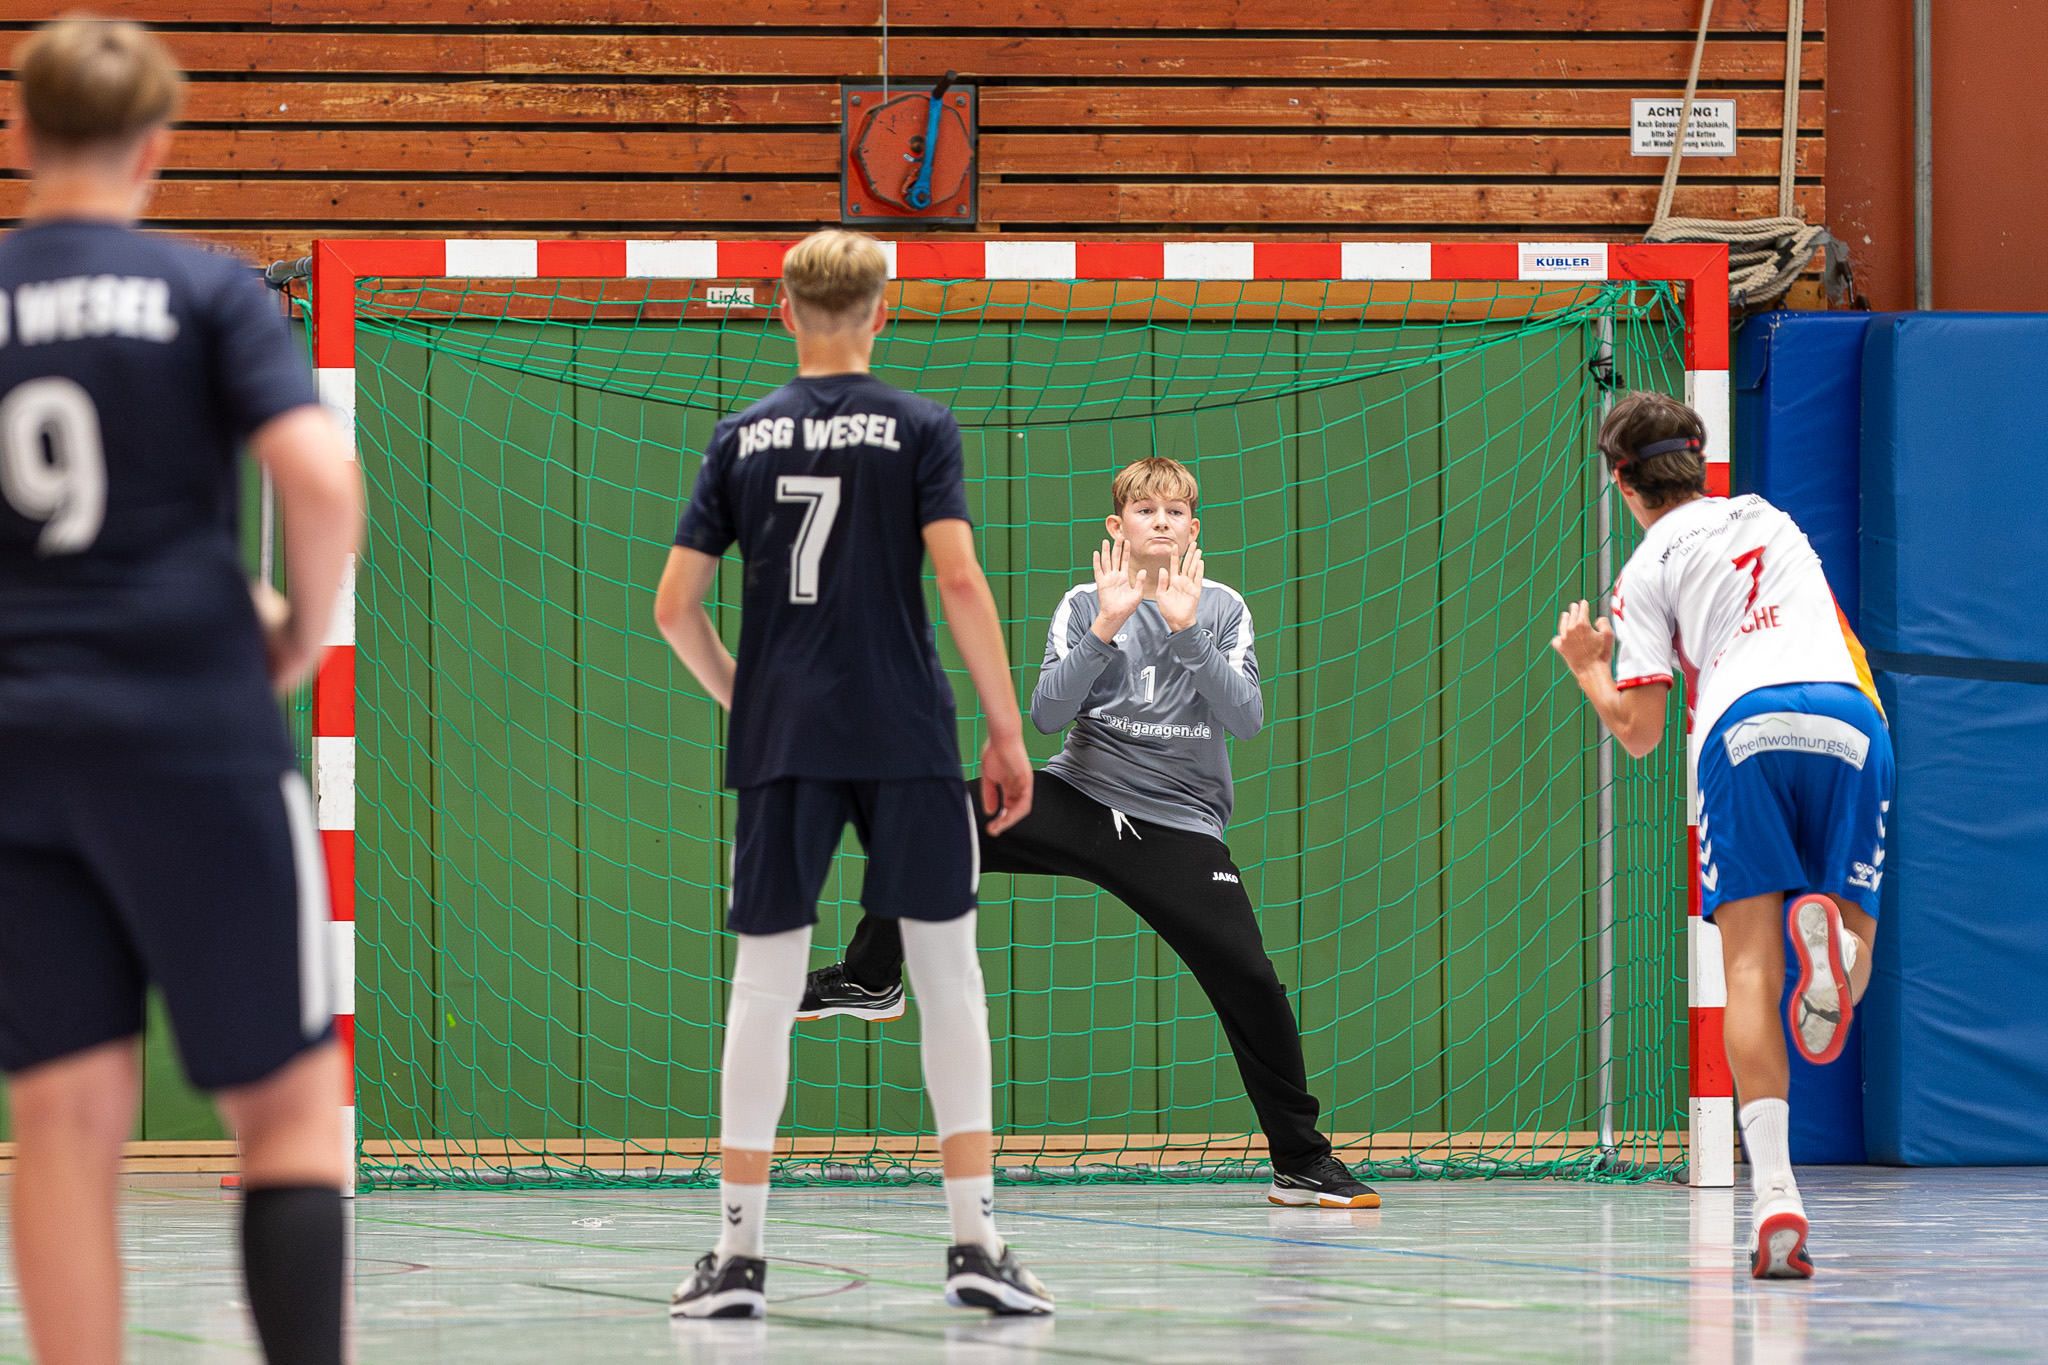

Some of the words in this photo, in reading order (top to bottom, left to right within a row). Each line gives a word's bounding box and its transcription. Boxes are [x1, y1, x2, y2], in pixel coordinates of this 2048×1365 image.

[1648, 107, 1712, 117] ACHTNG
[1536, 256, 1590, 267] KÜBLER
[14, 274, 180, 347] WESEL
[711, 290, 751, 304] Links
[738, 416, 795, 460] HSG
[803, 413, 901, 452] WESEL
[0, 376, 109, 558] 9
[775, 475, 841, 604] 7
[1140, 665, 1156, 703] 1
[1101, 713, 1212, 739] maxi-garagen.de
[1212, 871, 1239, 884] JAKO
